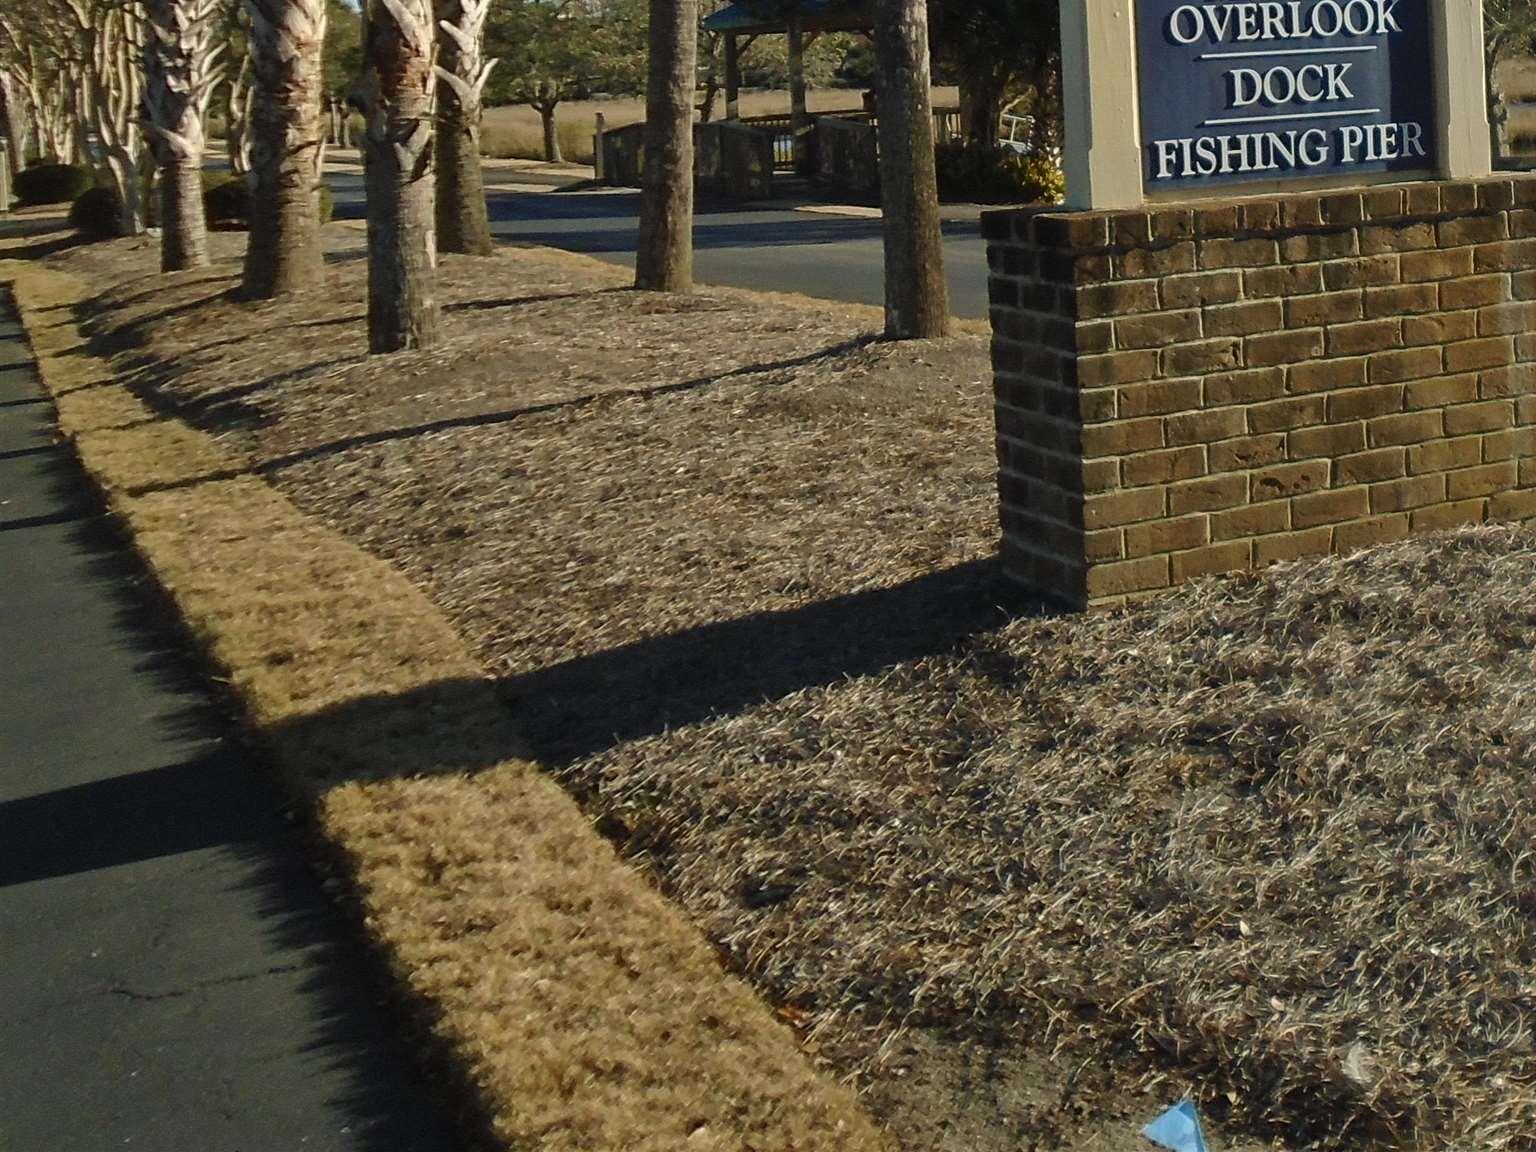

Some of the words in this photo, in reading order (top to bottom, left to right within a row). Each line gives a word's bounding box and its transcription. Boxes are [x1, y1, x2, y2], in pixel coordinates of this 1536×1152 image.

[1229, 63, 1354, 107] DOCK
[1153, 128, 1329, 178] FISHING
[1339, 121, 1426, 164] PIER
